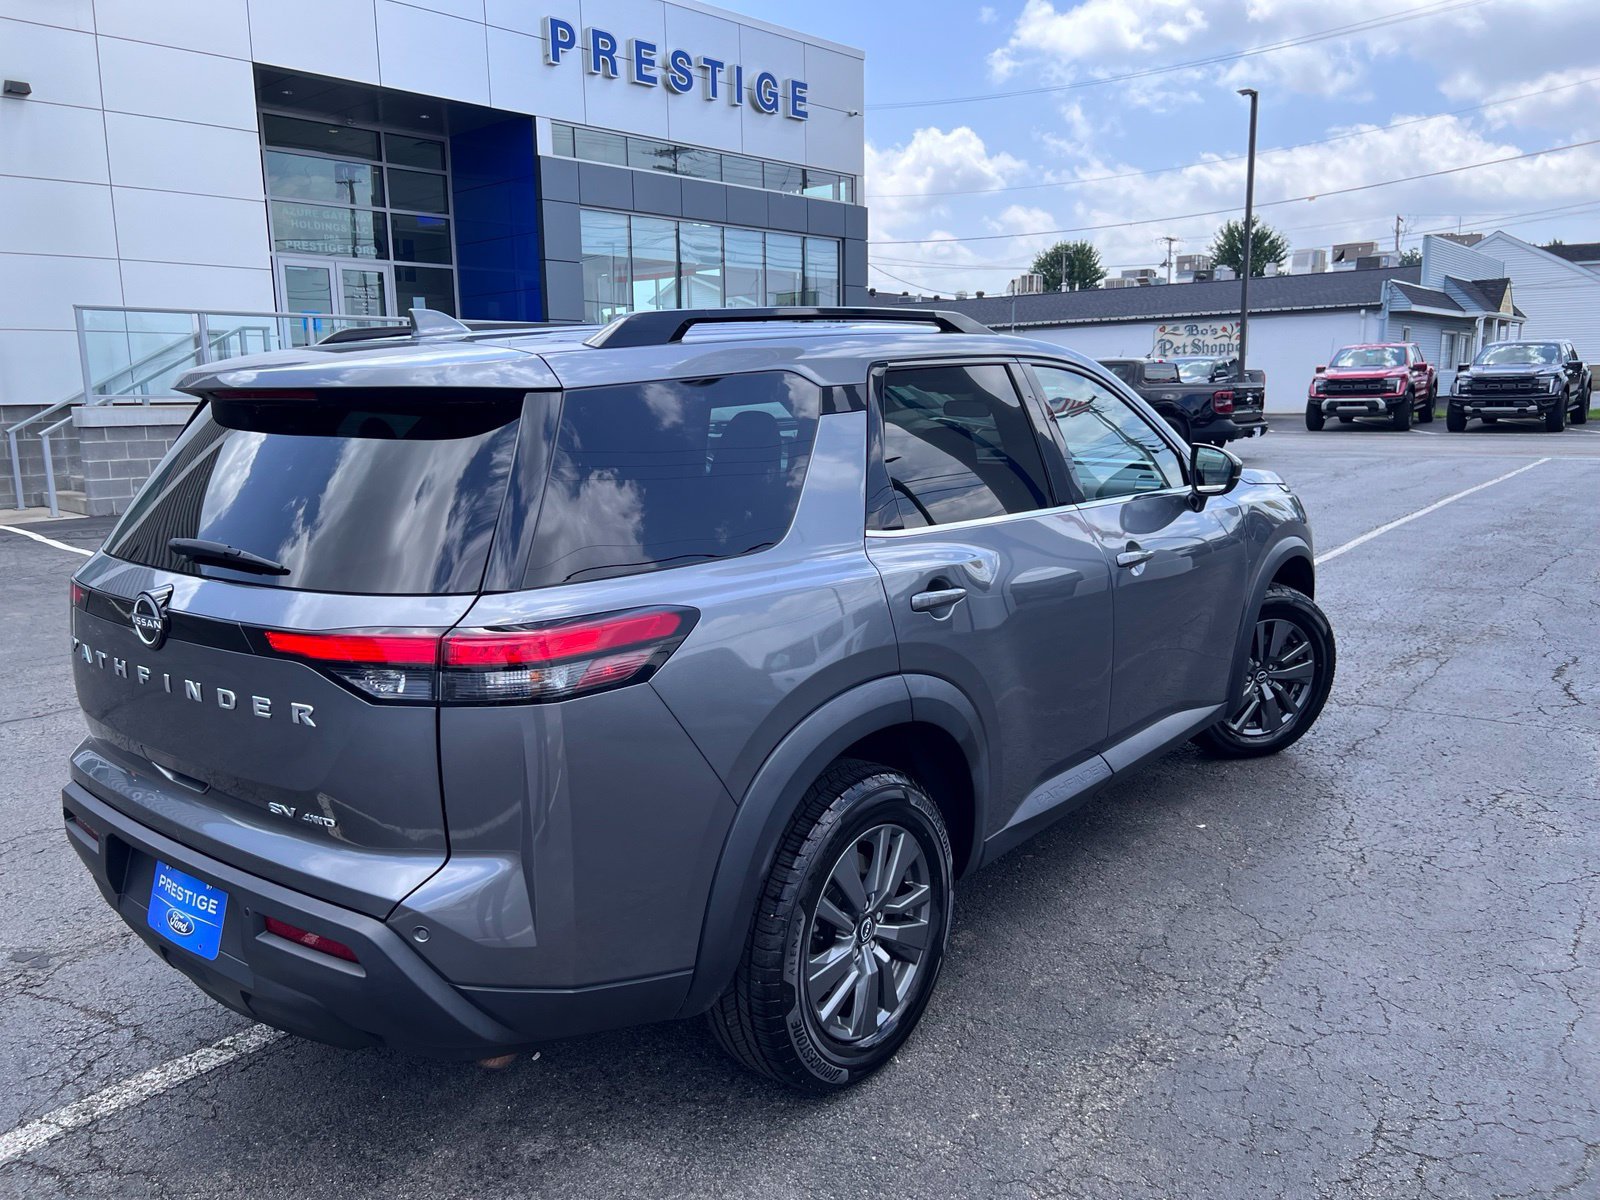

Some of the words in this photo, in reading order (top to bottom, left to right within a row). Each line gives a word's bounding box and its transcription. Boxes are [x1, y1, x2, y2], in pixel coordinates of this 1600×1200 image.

[543, 16, 809, 120] PRESTIGE
[291, 219, 347, 232] HOLDINGS
[285, 240, 344, 253] PRESTIGE
[347, 245, 378, 256] FORD
[1184, 324, 1218, 337] Bo's
[1157, 339, 1188, 357] Pet
[268, 802, 297, 818] SV
[158, 874, 218, 915] PRESTIGE
[169, 910, 189, 933] Ford
[790, 1019, 844, 1082] BRIDGESTONE
